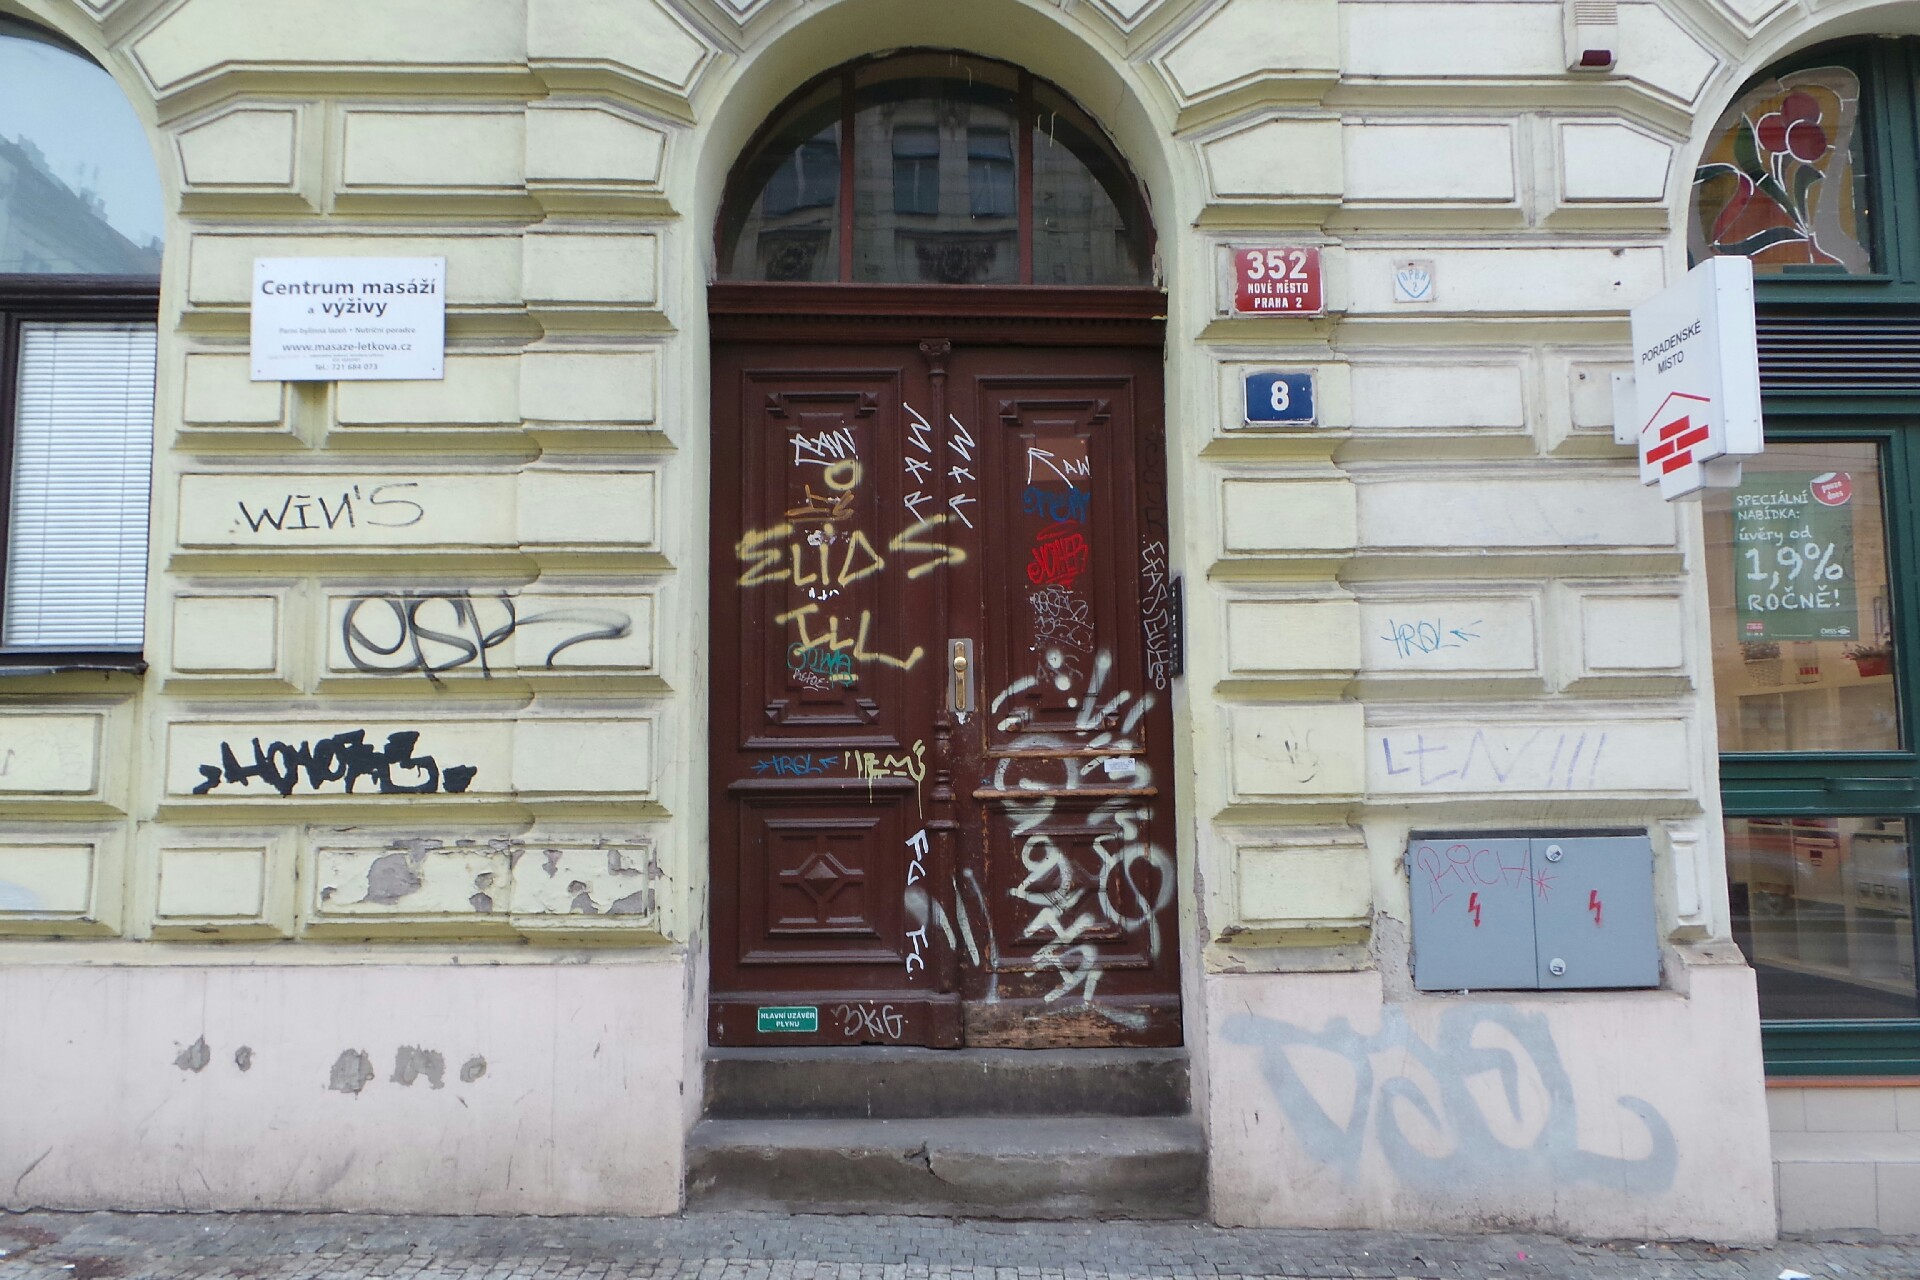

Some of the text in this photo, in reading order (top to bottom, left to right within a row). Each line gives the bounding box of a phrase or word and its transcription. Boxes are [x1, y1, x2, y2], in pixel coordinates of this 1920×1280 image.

[1246, 250, 1308, 280] 352
[262, 278, 436, 295] Centrum masáží
[1247, 279, 1309, 294] NOVÉ MĚSTO
[307, 297, 388, 317] a výživy
[1254, 297, 1302, 309] PRAHA 2
[386, 327, 416, 335] poradce
[282, 341, 412, 351] www.masaze-letkova.cz
[1641, 318, 1702, 365] PORADENSKÉ
[363, 363, 378, 371] 073
[1657, 350, 1684, 375] MÍSTO
[1270, 380, 1290, 411] 8
[1736, 489, 1809, 506] SPECIÁLNÍ
[1738, 505, 1801, 520] NABÍDKA:
[1739, 525, 1813, 546] úvěry od
[1745, 542, 1844, 590] 1,9%
[1747, 584, 1841, 612] ROČNĚ!
[760, 1011, 816, 1020] HLAVNÍ UZÁVĚR
[776, 1020, 801, 1028] PLYNU
